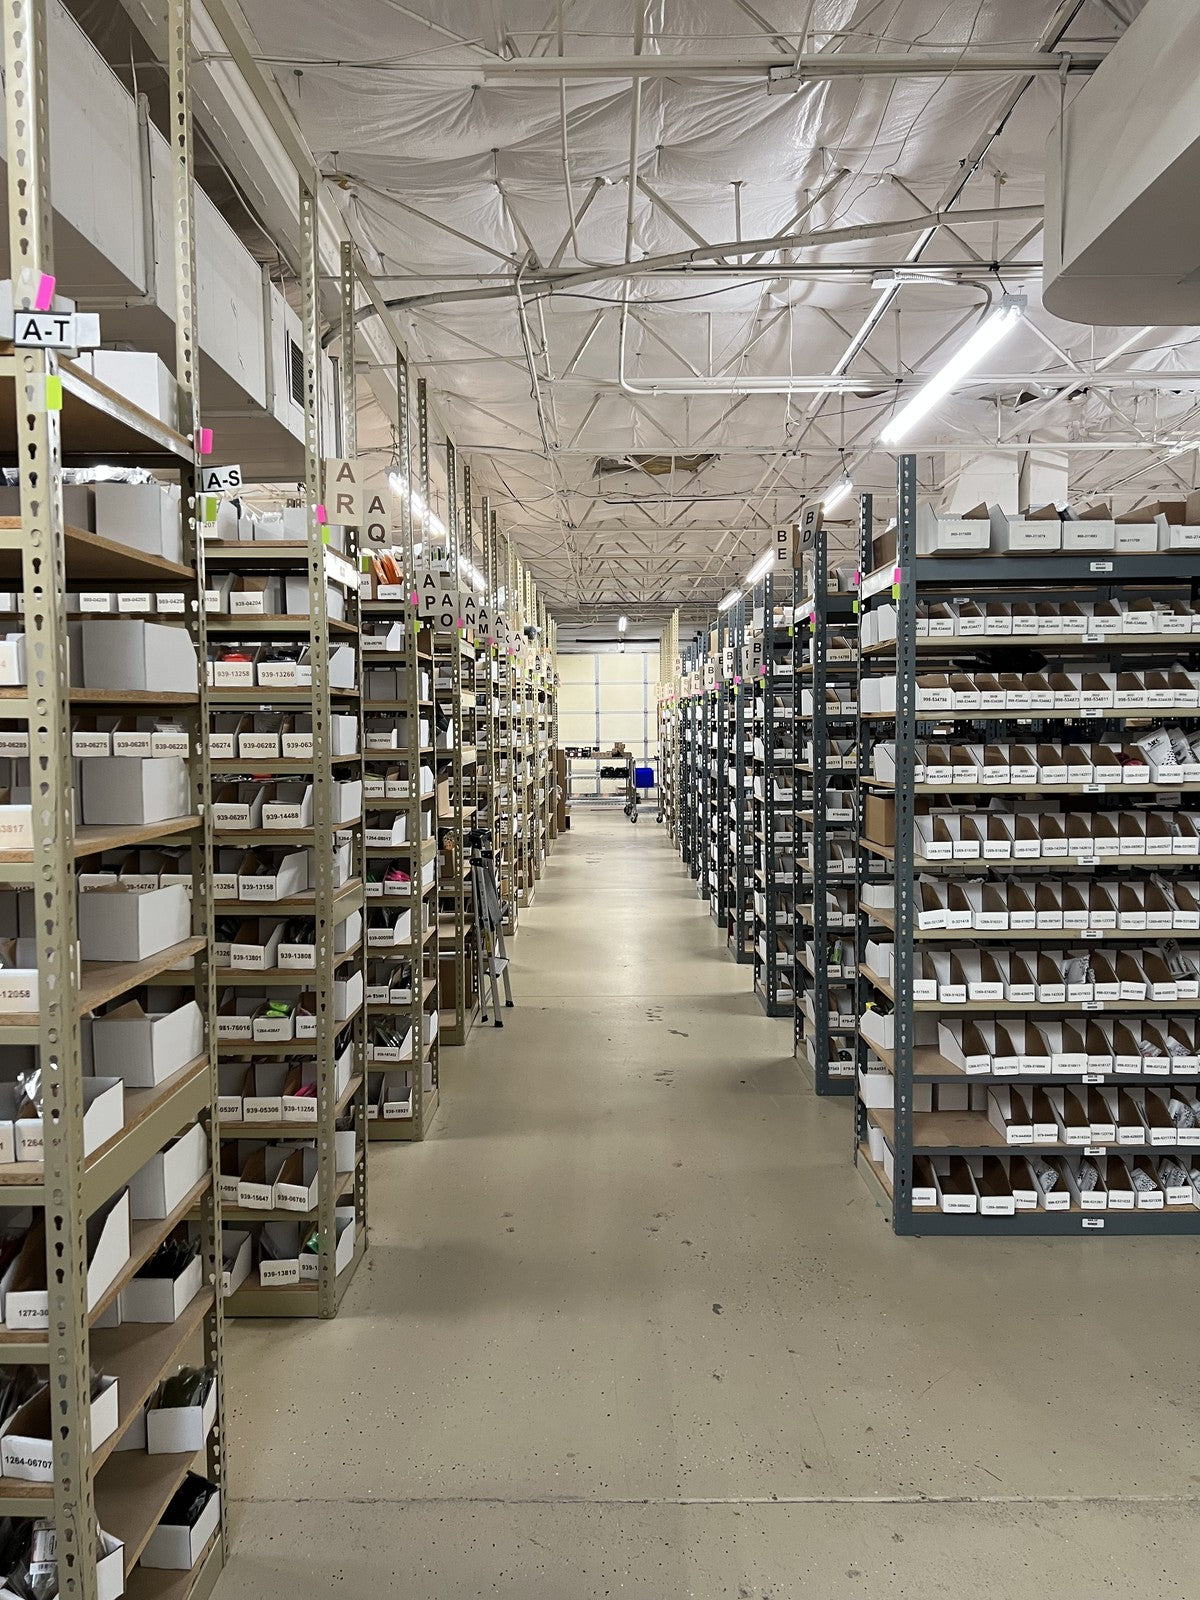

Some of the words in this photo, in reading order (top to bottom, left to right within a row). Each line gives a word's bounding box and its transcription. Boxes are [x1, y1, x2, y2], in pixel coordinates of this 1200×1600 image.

[23, 318, 70, 342] A-T
[207, 470, 240, 489] A-S
[263, 1269, 297, 1278] 939-13810
